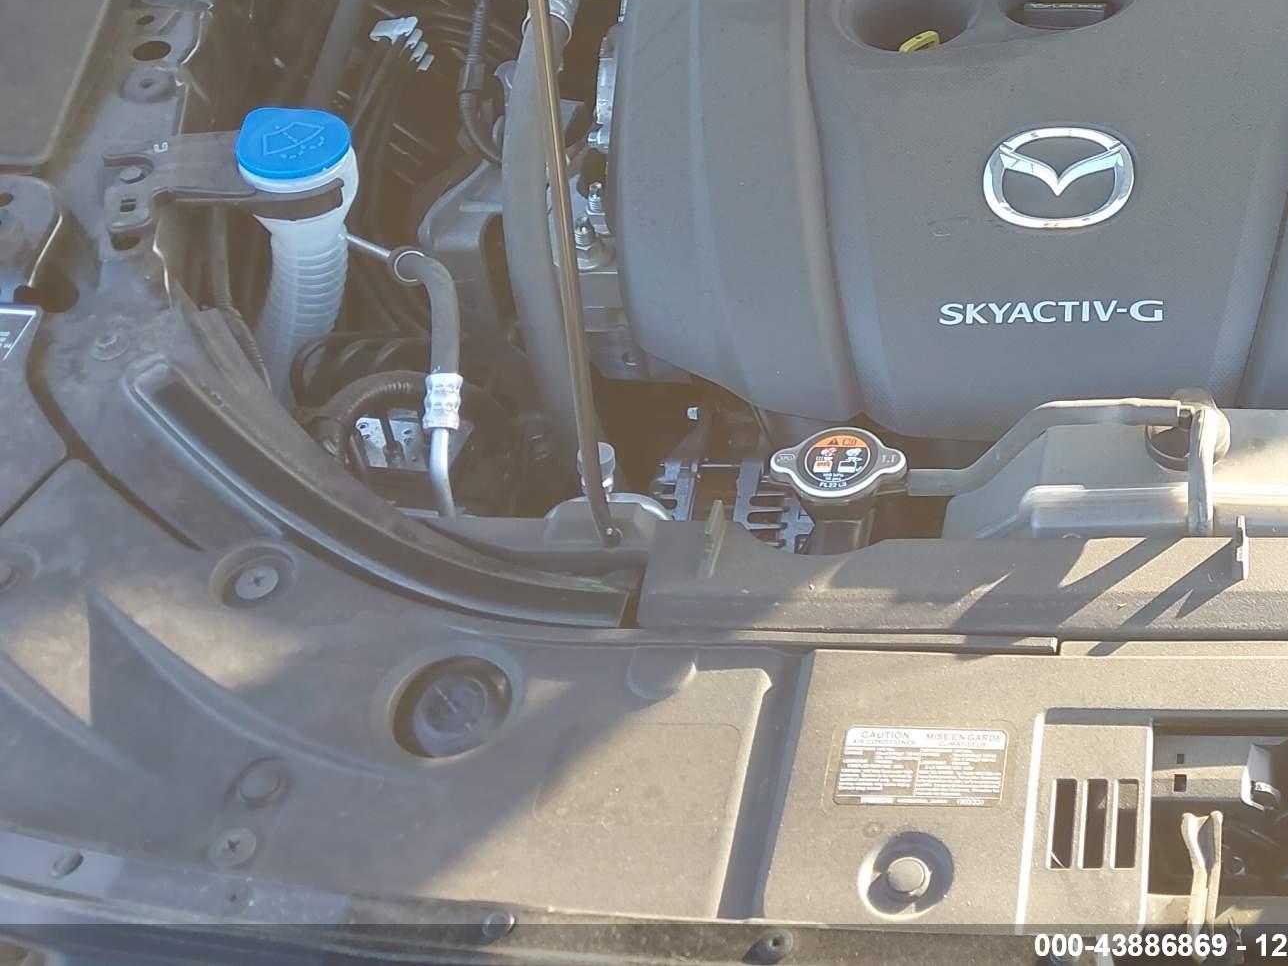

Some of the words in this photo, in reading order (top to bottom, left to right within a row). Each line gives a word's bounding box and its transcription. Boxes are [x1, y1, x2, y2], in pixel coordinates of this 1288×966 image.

[938, 300, 1164, 325] SKYACTIV-G
[861, 730, 911, 739] CAUTION
[967, 734, 1001, 742] GARDE
